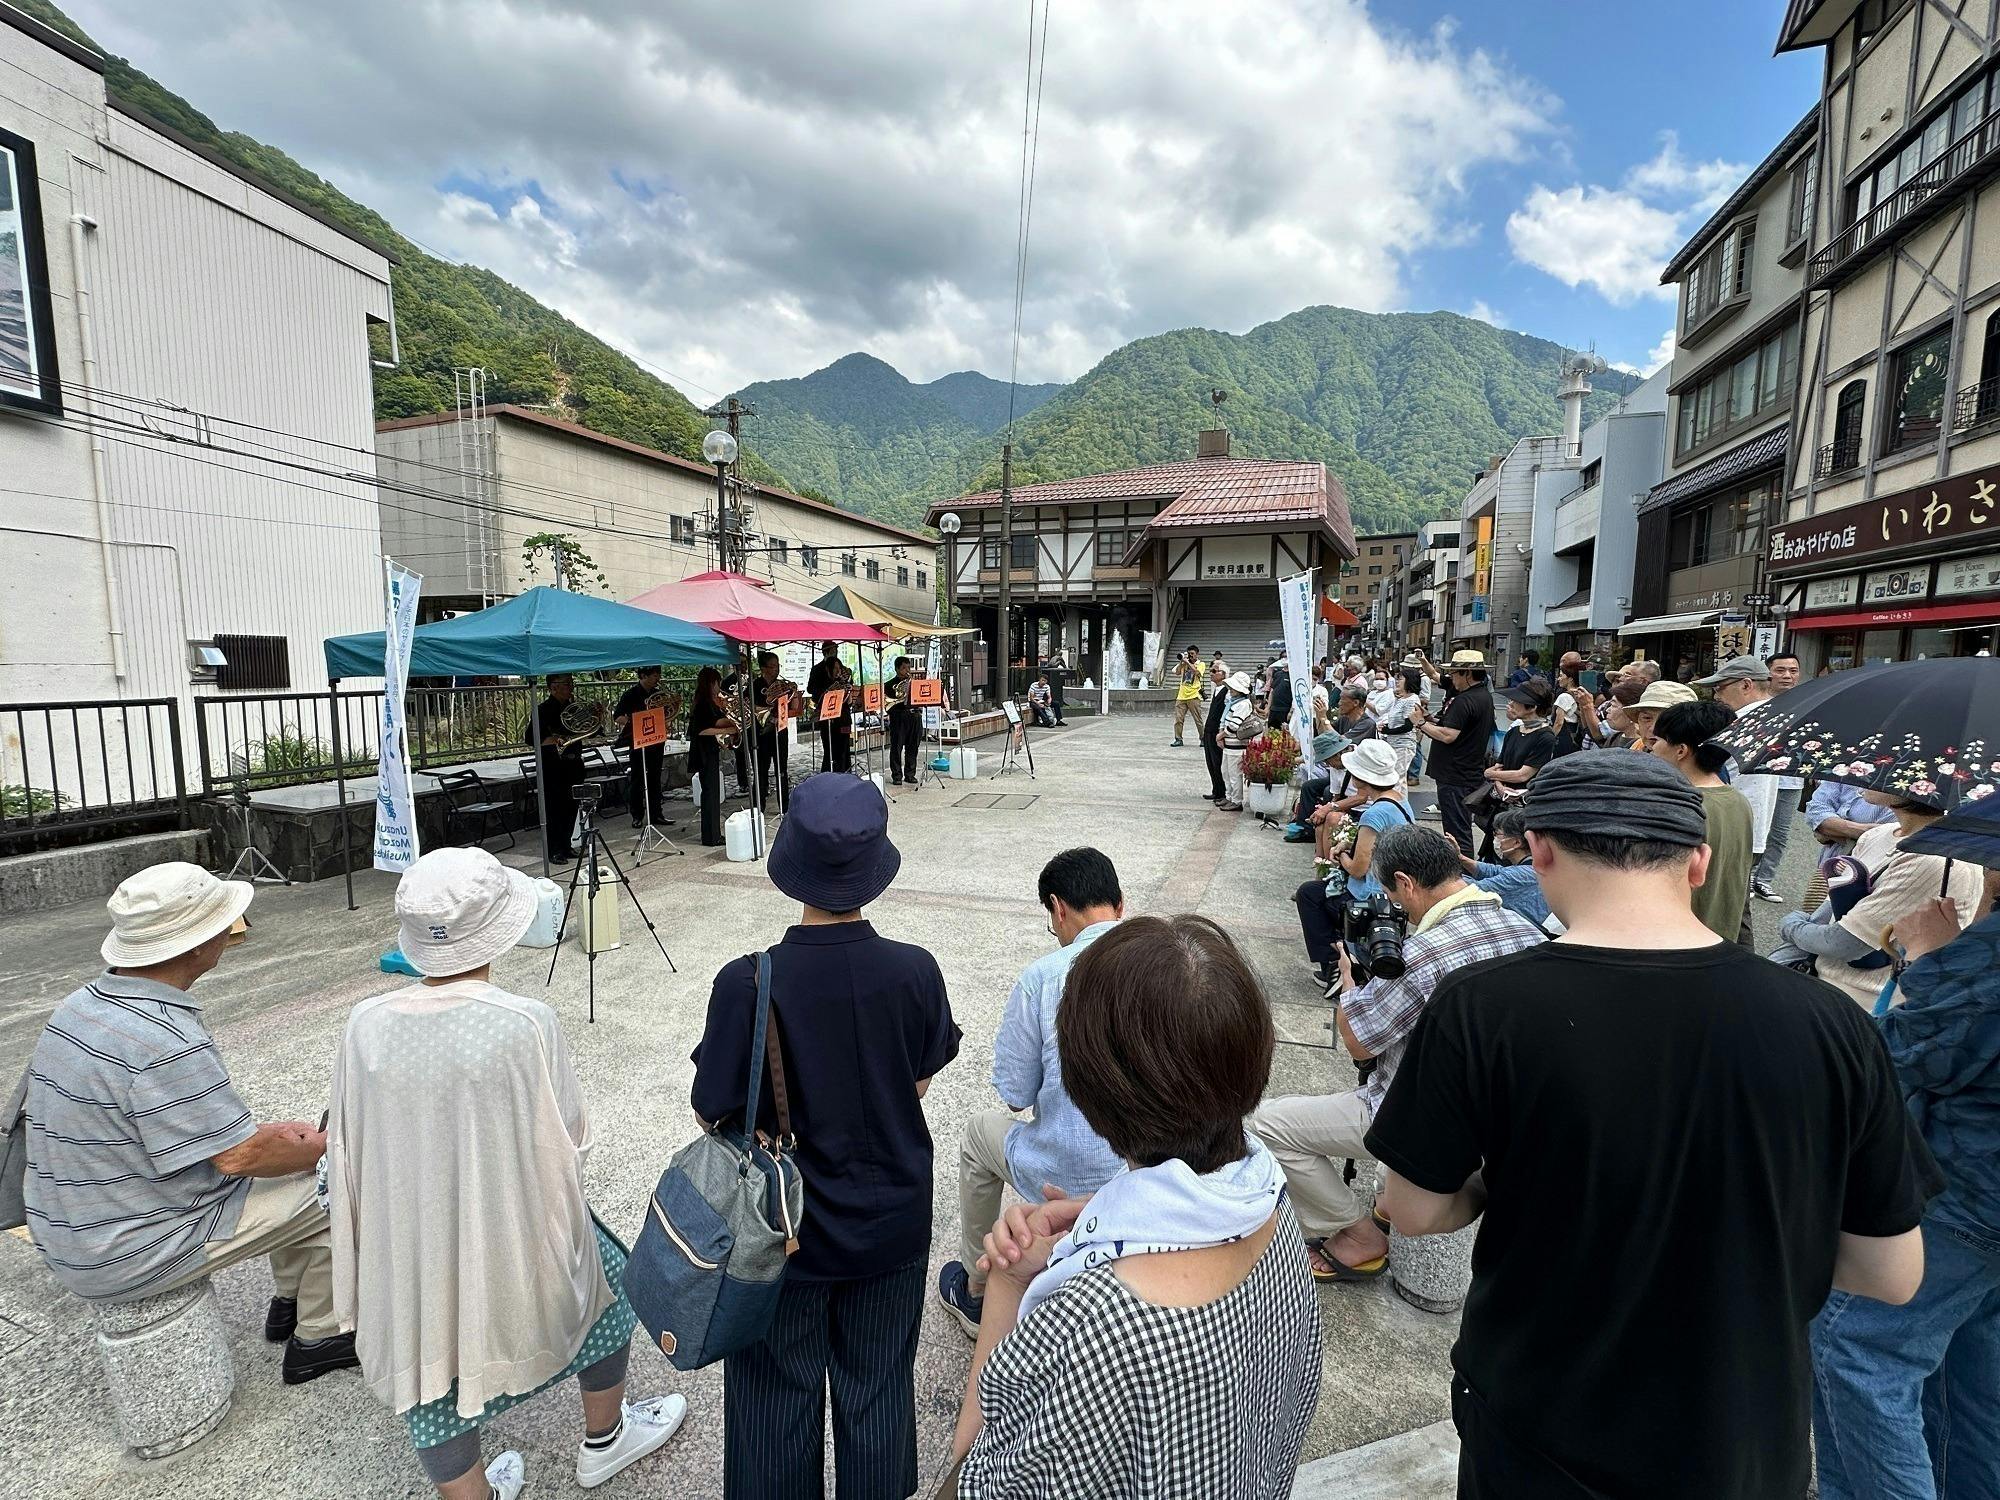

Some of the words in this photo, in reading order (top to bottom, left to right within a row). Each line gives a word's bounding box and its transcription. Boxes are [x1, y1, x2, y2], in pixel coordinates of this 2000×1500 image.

[1881, 478, 1997, 541] いわさ
[1769, 524, 1857, 562] 酒おみやげの店
[1207, 563, 1265, 576] 宇奈月温泉駅
[1953, 573, 1981, 590] 喫茶
